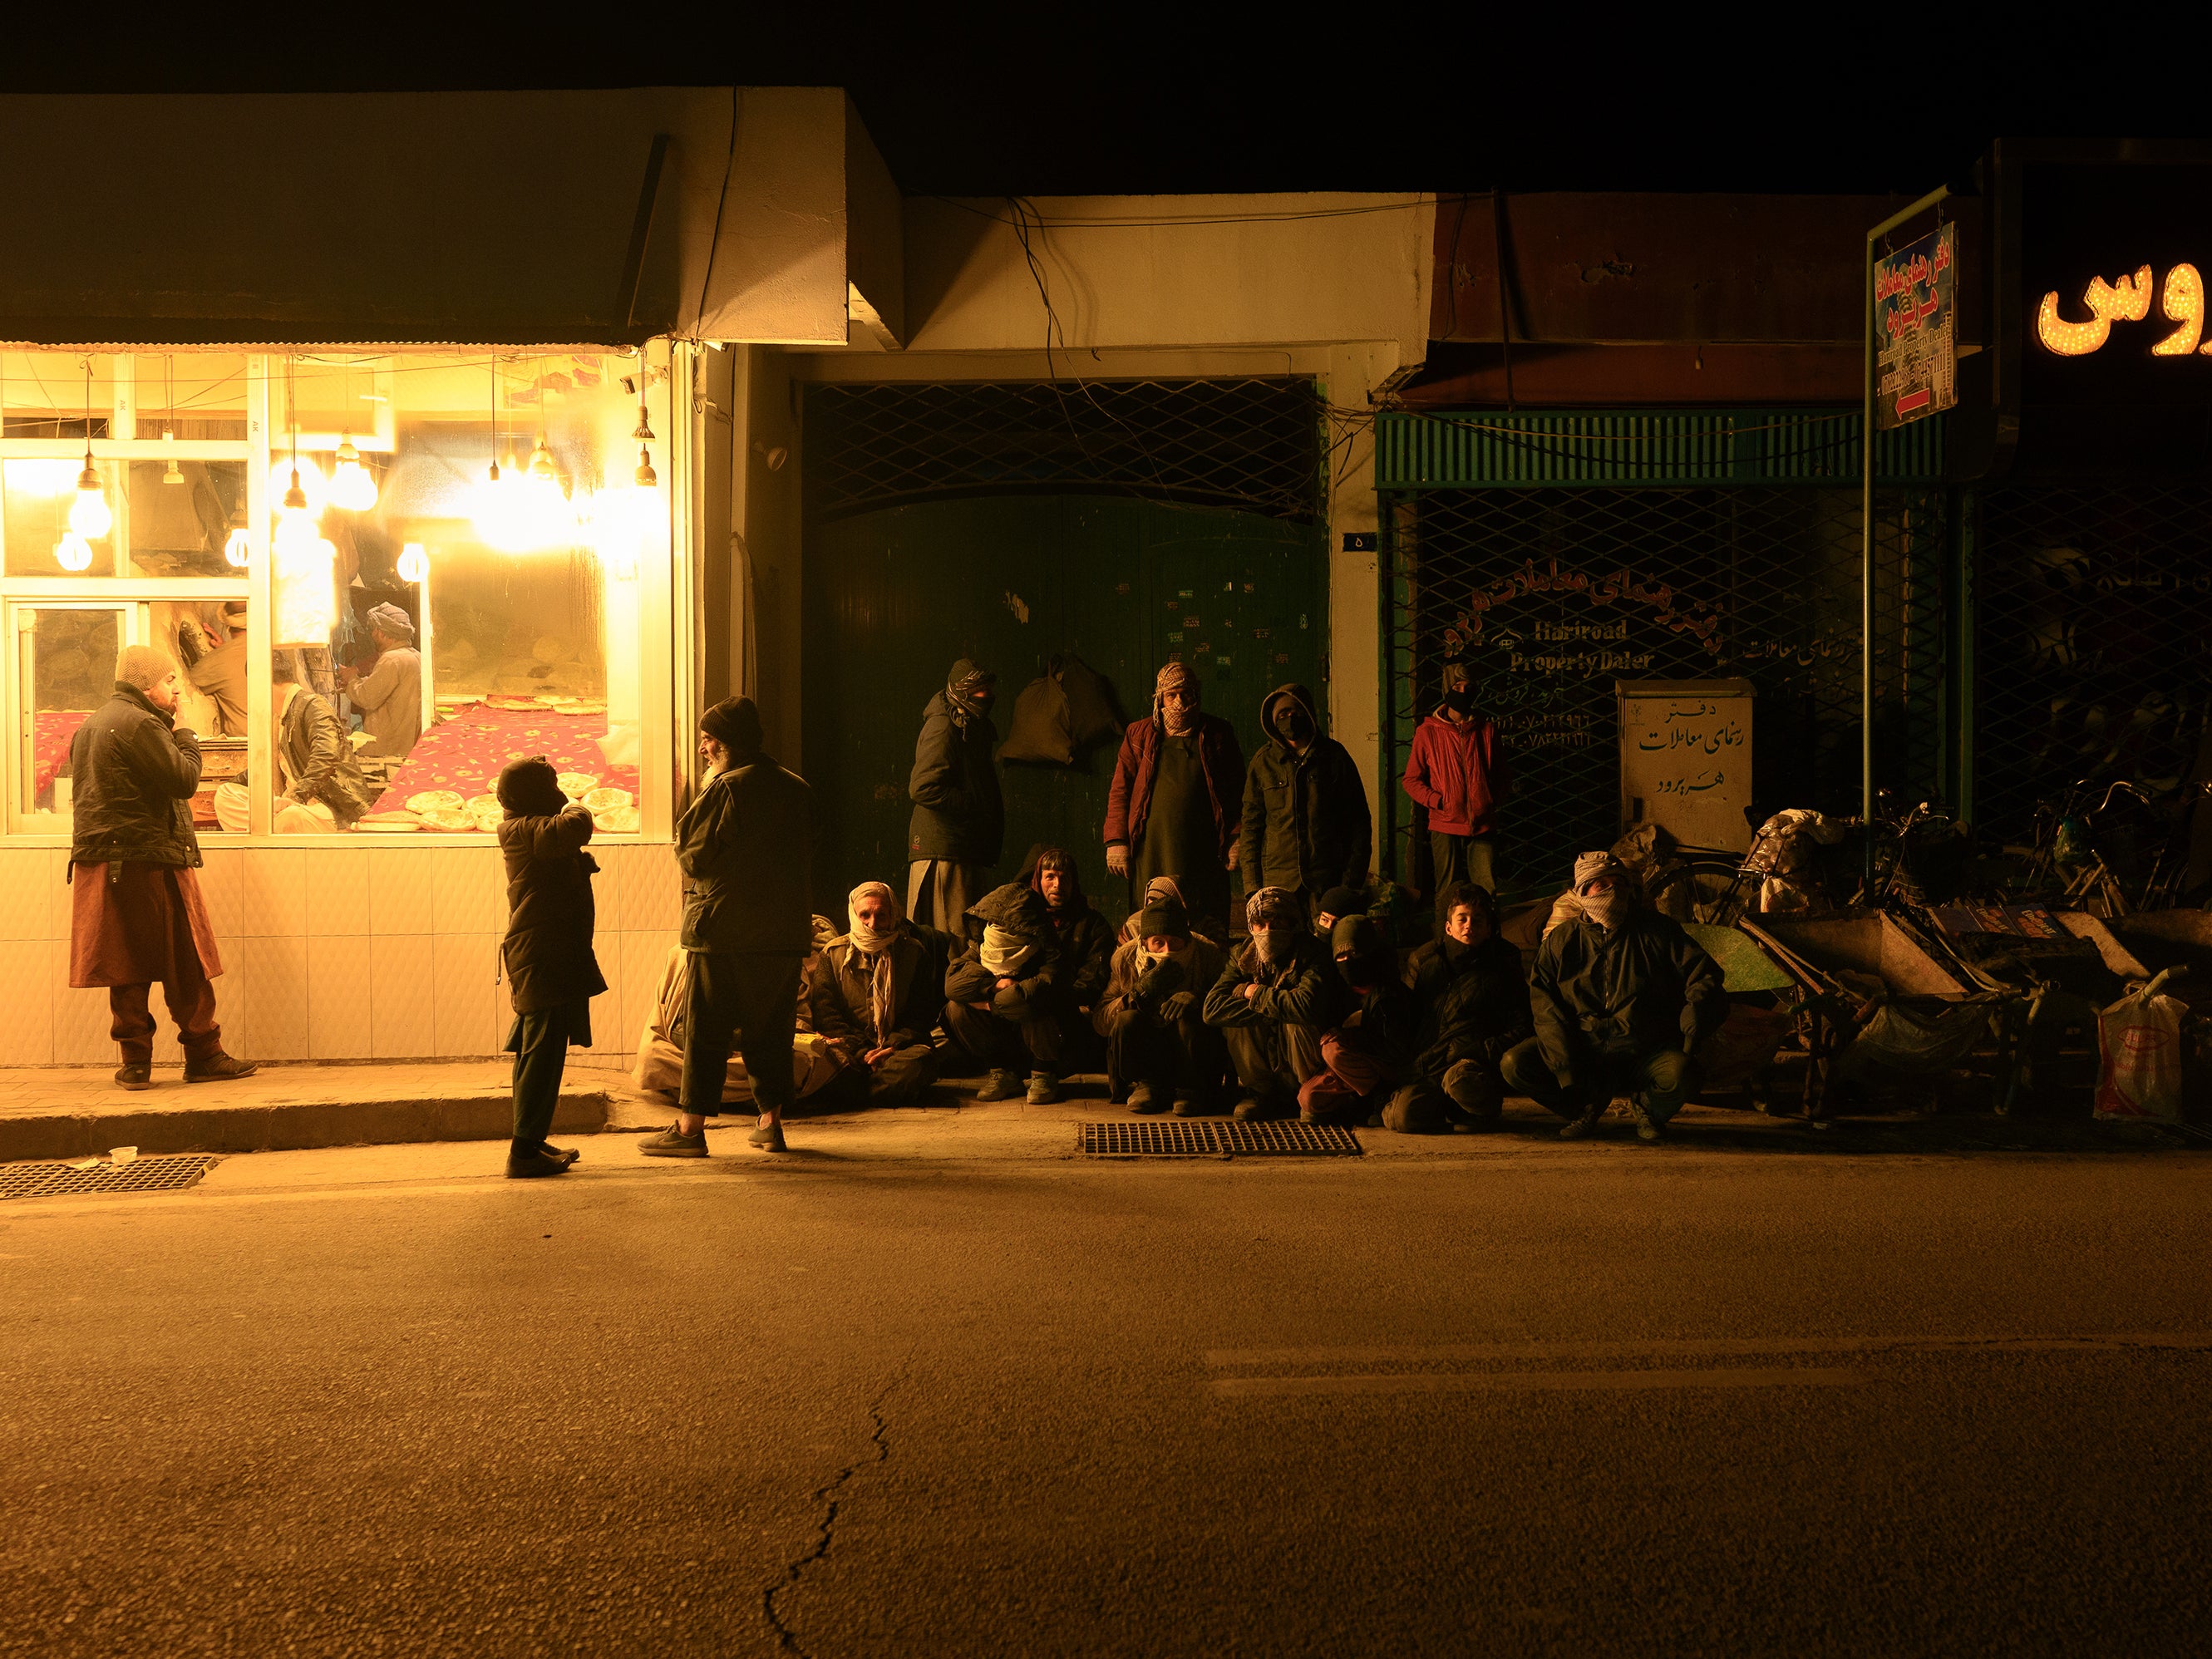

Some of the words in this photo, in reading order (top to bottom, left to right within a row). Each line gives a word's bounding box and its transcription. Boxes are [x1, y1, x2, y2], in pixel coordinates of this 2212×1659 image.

[1904, 253, 1933, 296] رهنمای
[1933, 235, 1951, 283] دفتر
[1876, 263, 1906, 302] معاملات
[1887, 287, 1938, 340] هریرود
[1904, 336, 1929, 357] Property
[1488, 558, 1589, 605] معاملات
[1535, 618, 1628, 641] Hariroad
[1509, 652, 1597, 679] Property
[1599, 650, 1655, 671] Daler
[1665, 700, 1717, 723] دفتر
[1639, 726, 1702, 751] معاملات
